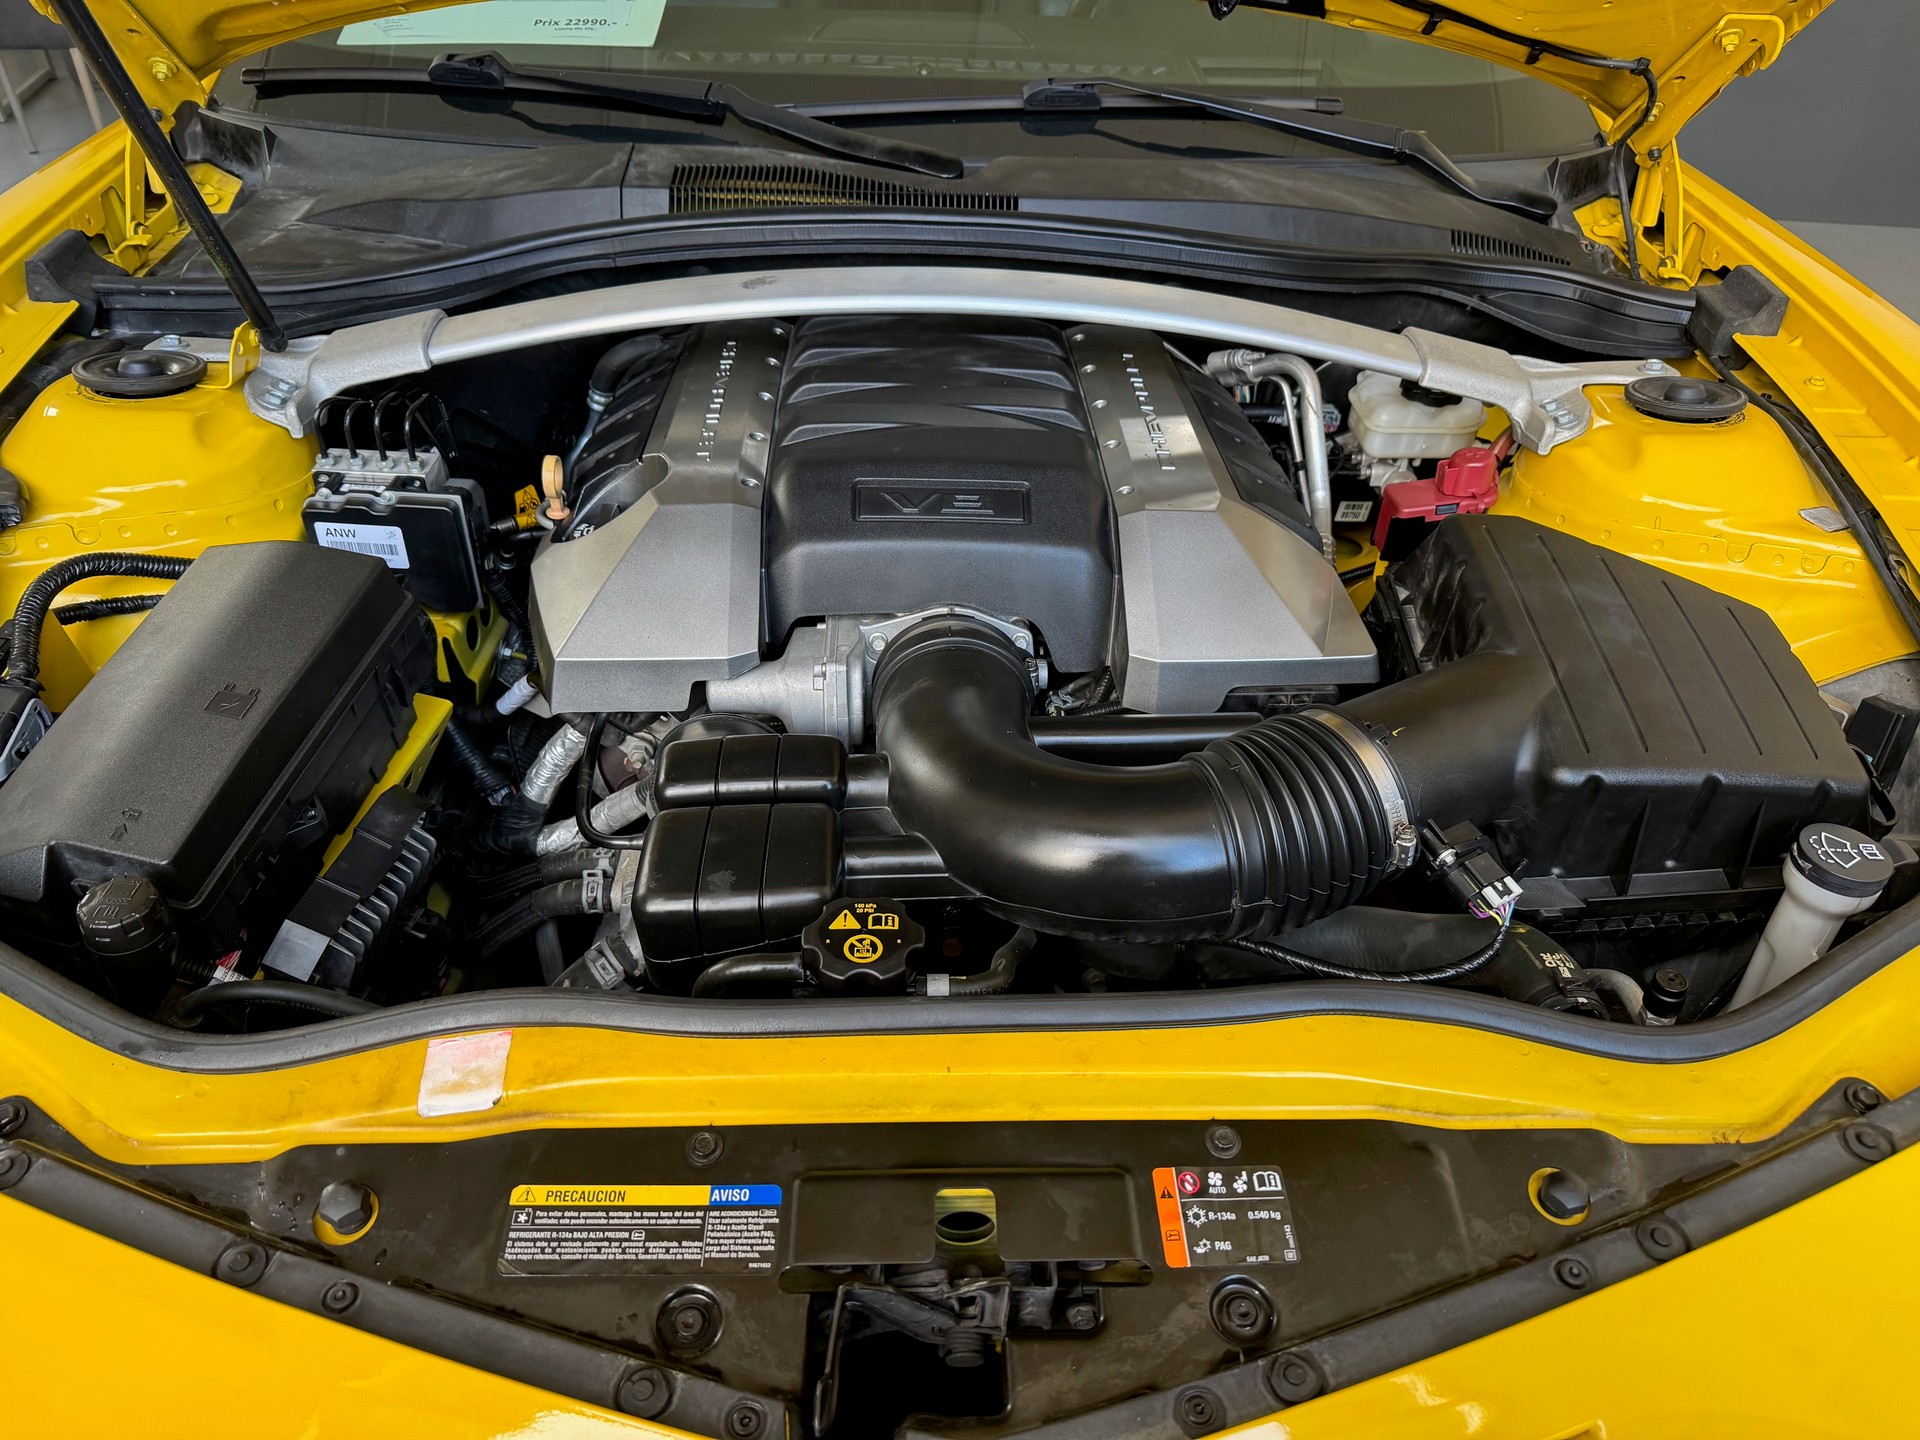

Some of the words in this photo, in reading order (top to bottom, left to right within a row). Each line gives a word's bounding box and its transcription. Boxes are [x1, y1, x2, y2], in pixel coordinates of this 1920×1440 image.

[326, 528, 356, 538] ANW
[546, 1190, 626, 1202] PRECAUCION
[711, 1189, 750, 1202] AVISO
[1208, 1212, 1236, 1220] R-134a
[1248, 1211, 1269, 1219] 0.540
[1270, 1210, 1281, 1220] kg
[1215, 1241, 1232, 1250] PAG
